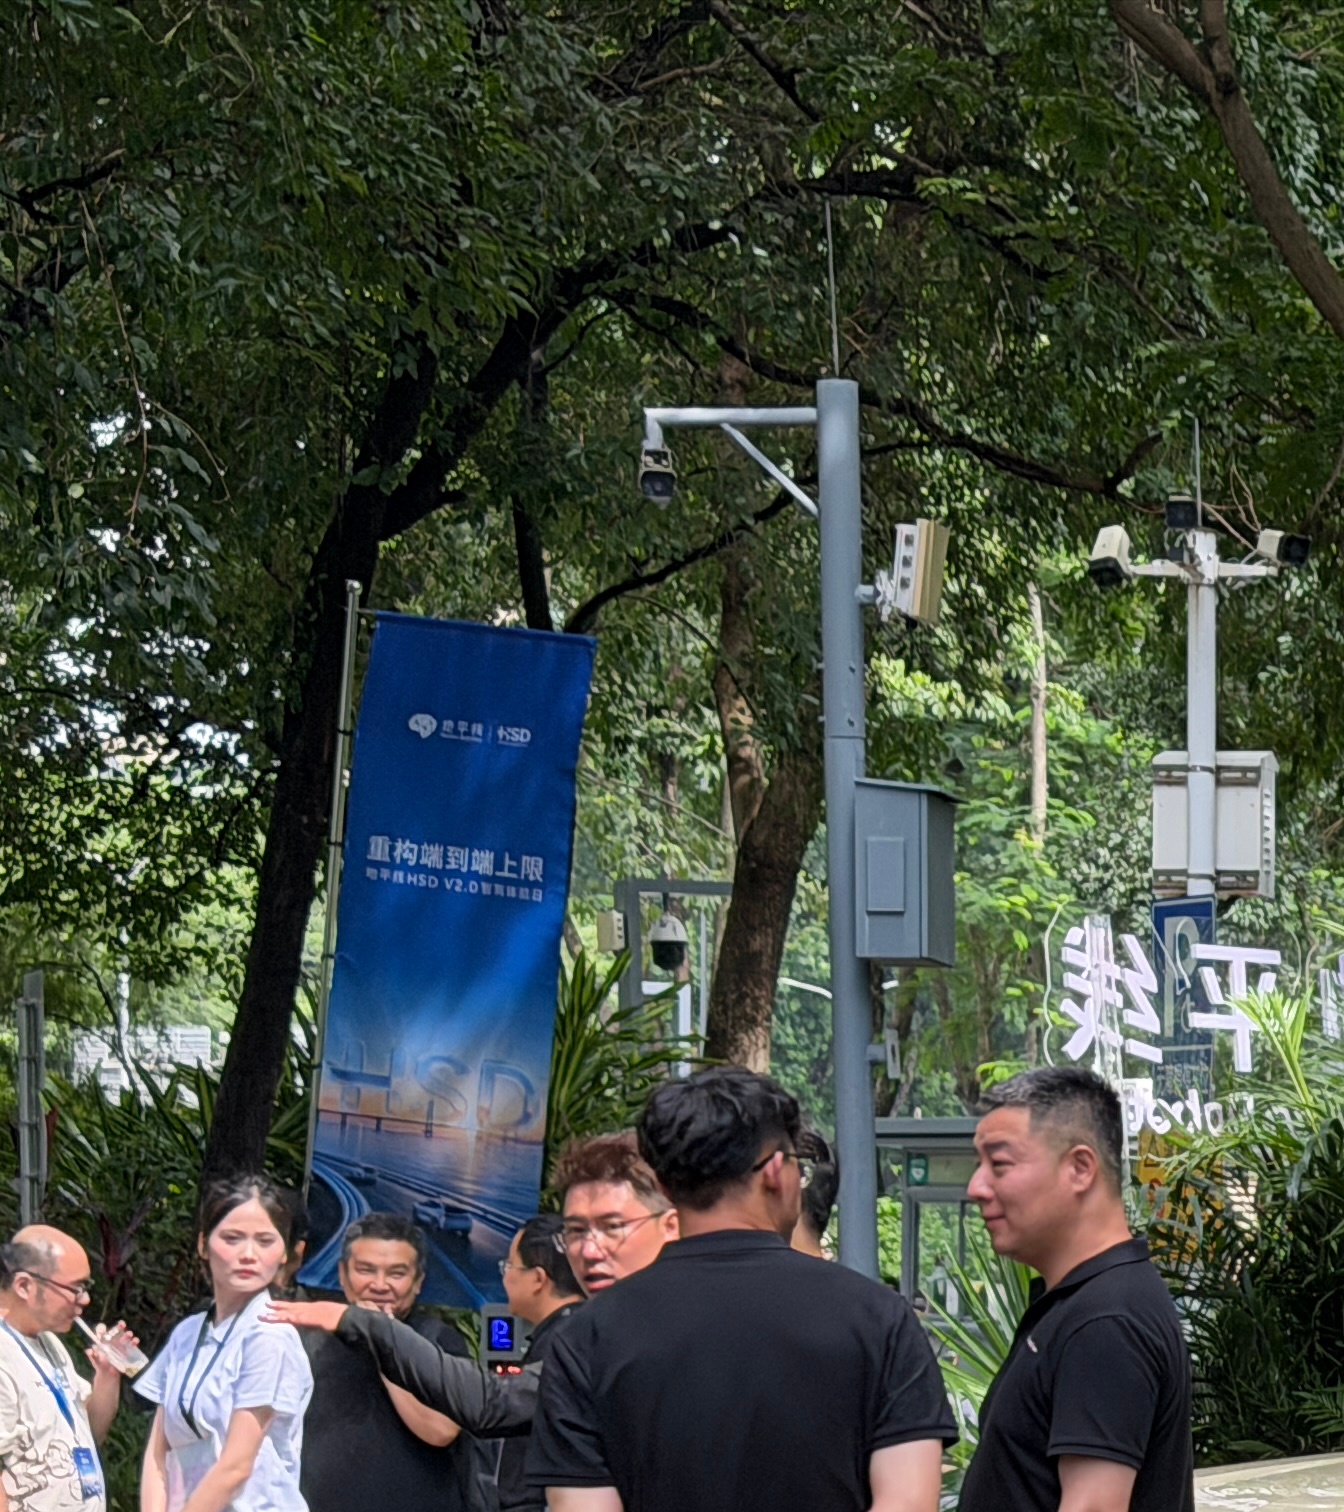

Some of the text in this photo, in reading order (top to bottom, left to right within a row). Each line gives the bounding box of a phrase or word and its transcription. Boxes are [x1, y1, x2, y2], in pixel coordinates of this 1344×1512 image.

[366, 835, 544, 882] 重构端到端上限
